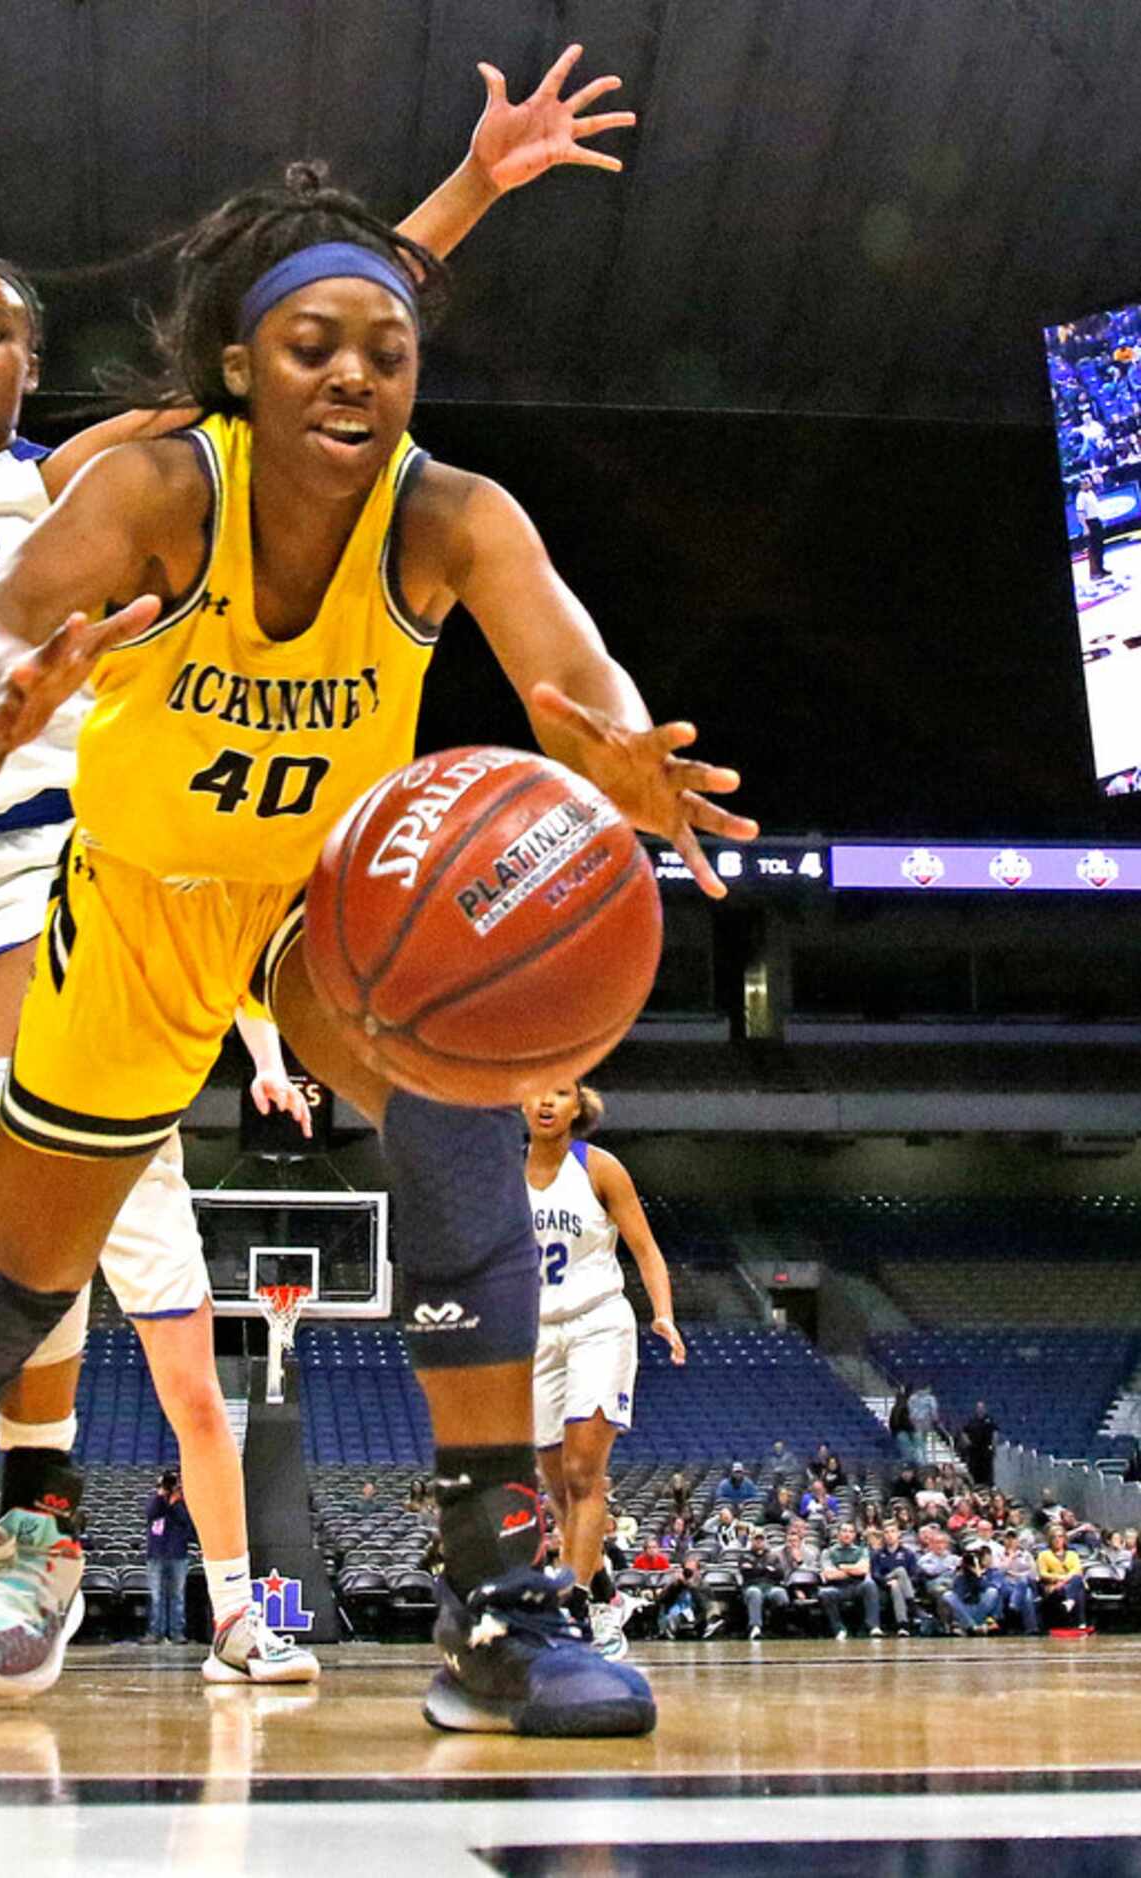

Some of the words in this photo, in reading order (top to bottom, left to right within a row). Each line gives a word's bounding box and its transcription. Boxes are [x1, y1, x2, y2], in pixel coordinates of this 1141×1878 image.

[189, 750, 330, 817] 40
[757, 859, 793, 875] TOL
[798, 852, 823, 878] 4
[534, 1208, 583, 1238] GARS
[538, 1241, 569, 1286] 2
